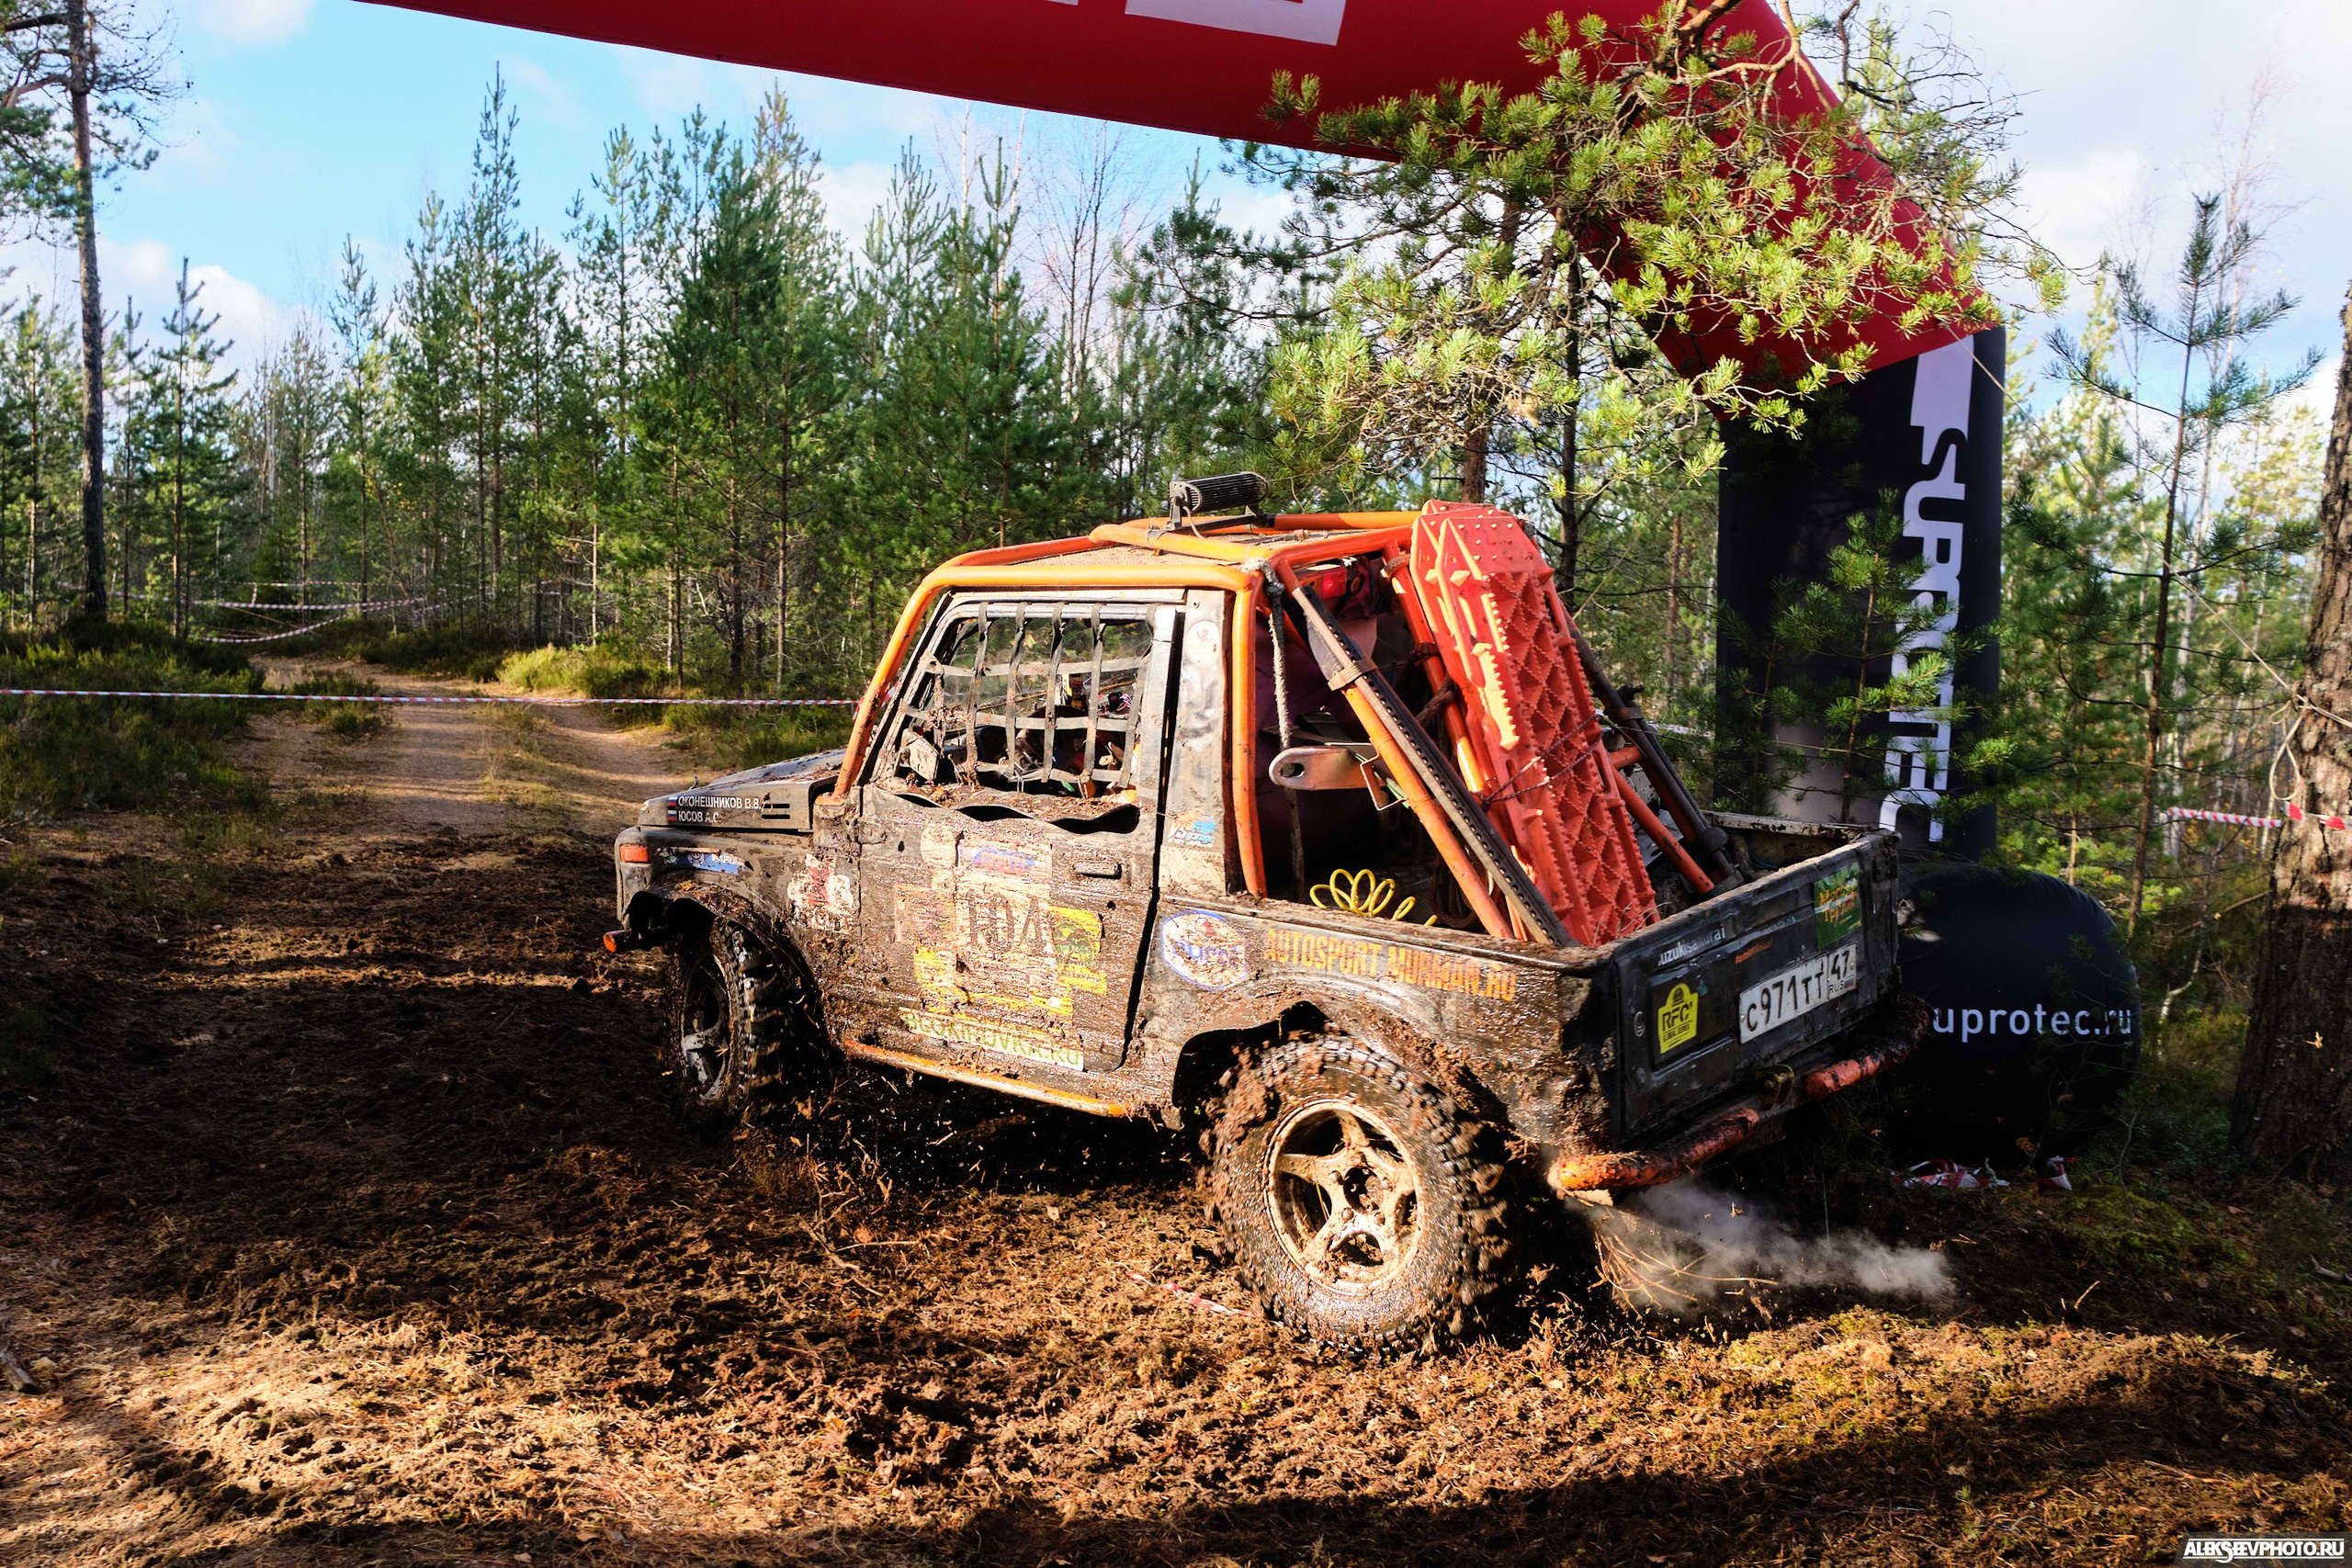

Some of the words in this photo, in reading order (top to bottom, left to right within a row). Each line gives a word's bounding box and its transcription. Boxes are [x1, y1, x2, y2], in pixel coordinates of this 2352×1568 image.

[678, 795, 742, 808] ОКОНЕШНИКОВ
[678, 810, 703, 822] ЮСОВ
[1264, 928, 1382, 976] AUTOSPORT
[1829, 979, 1844, 993] RUS
